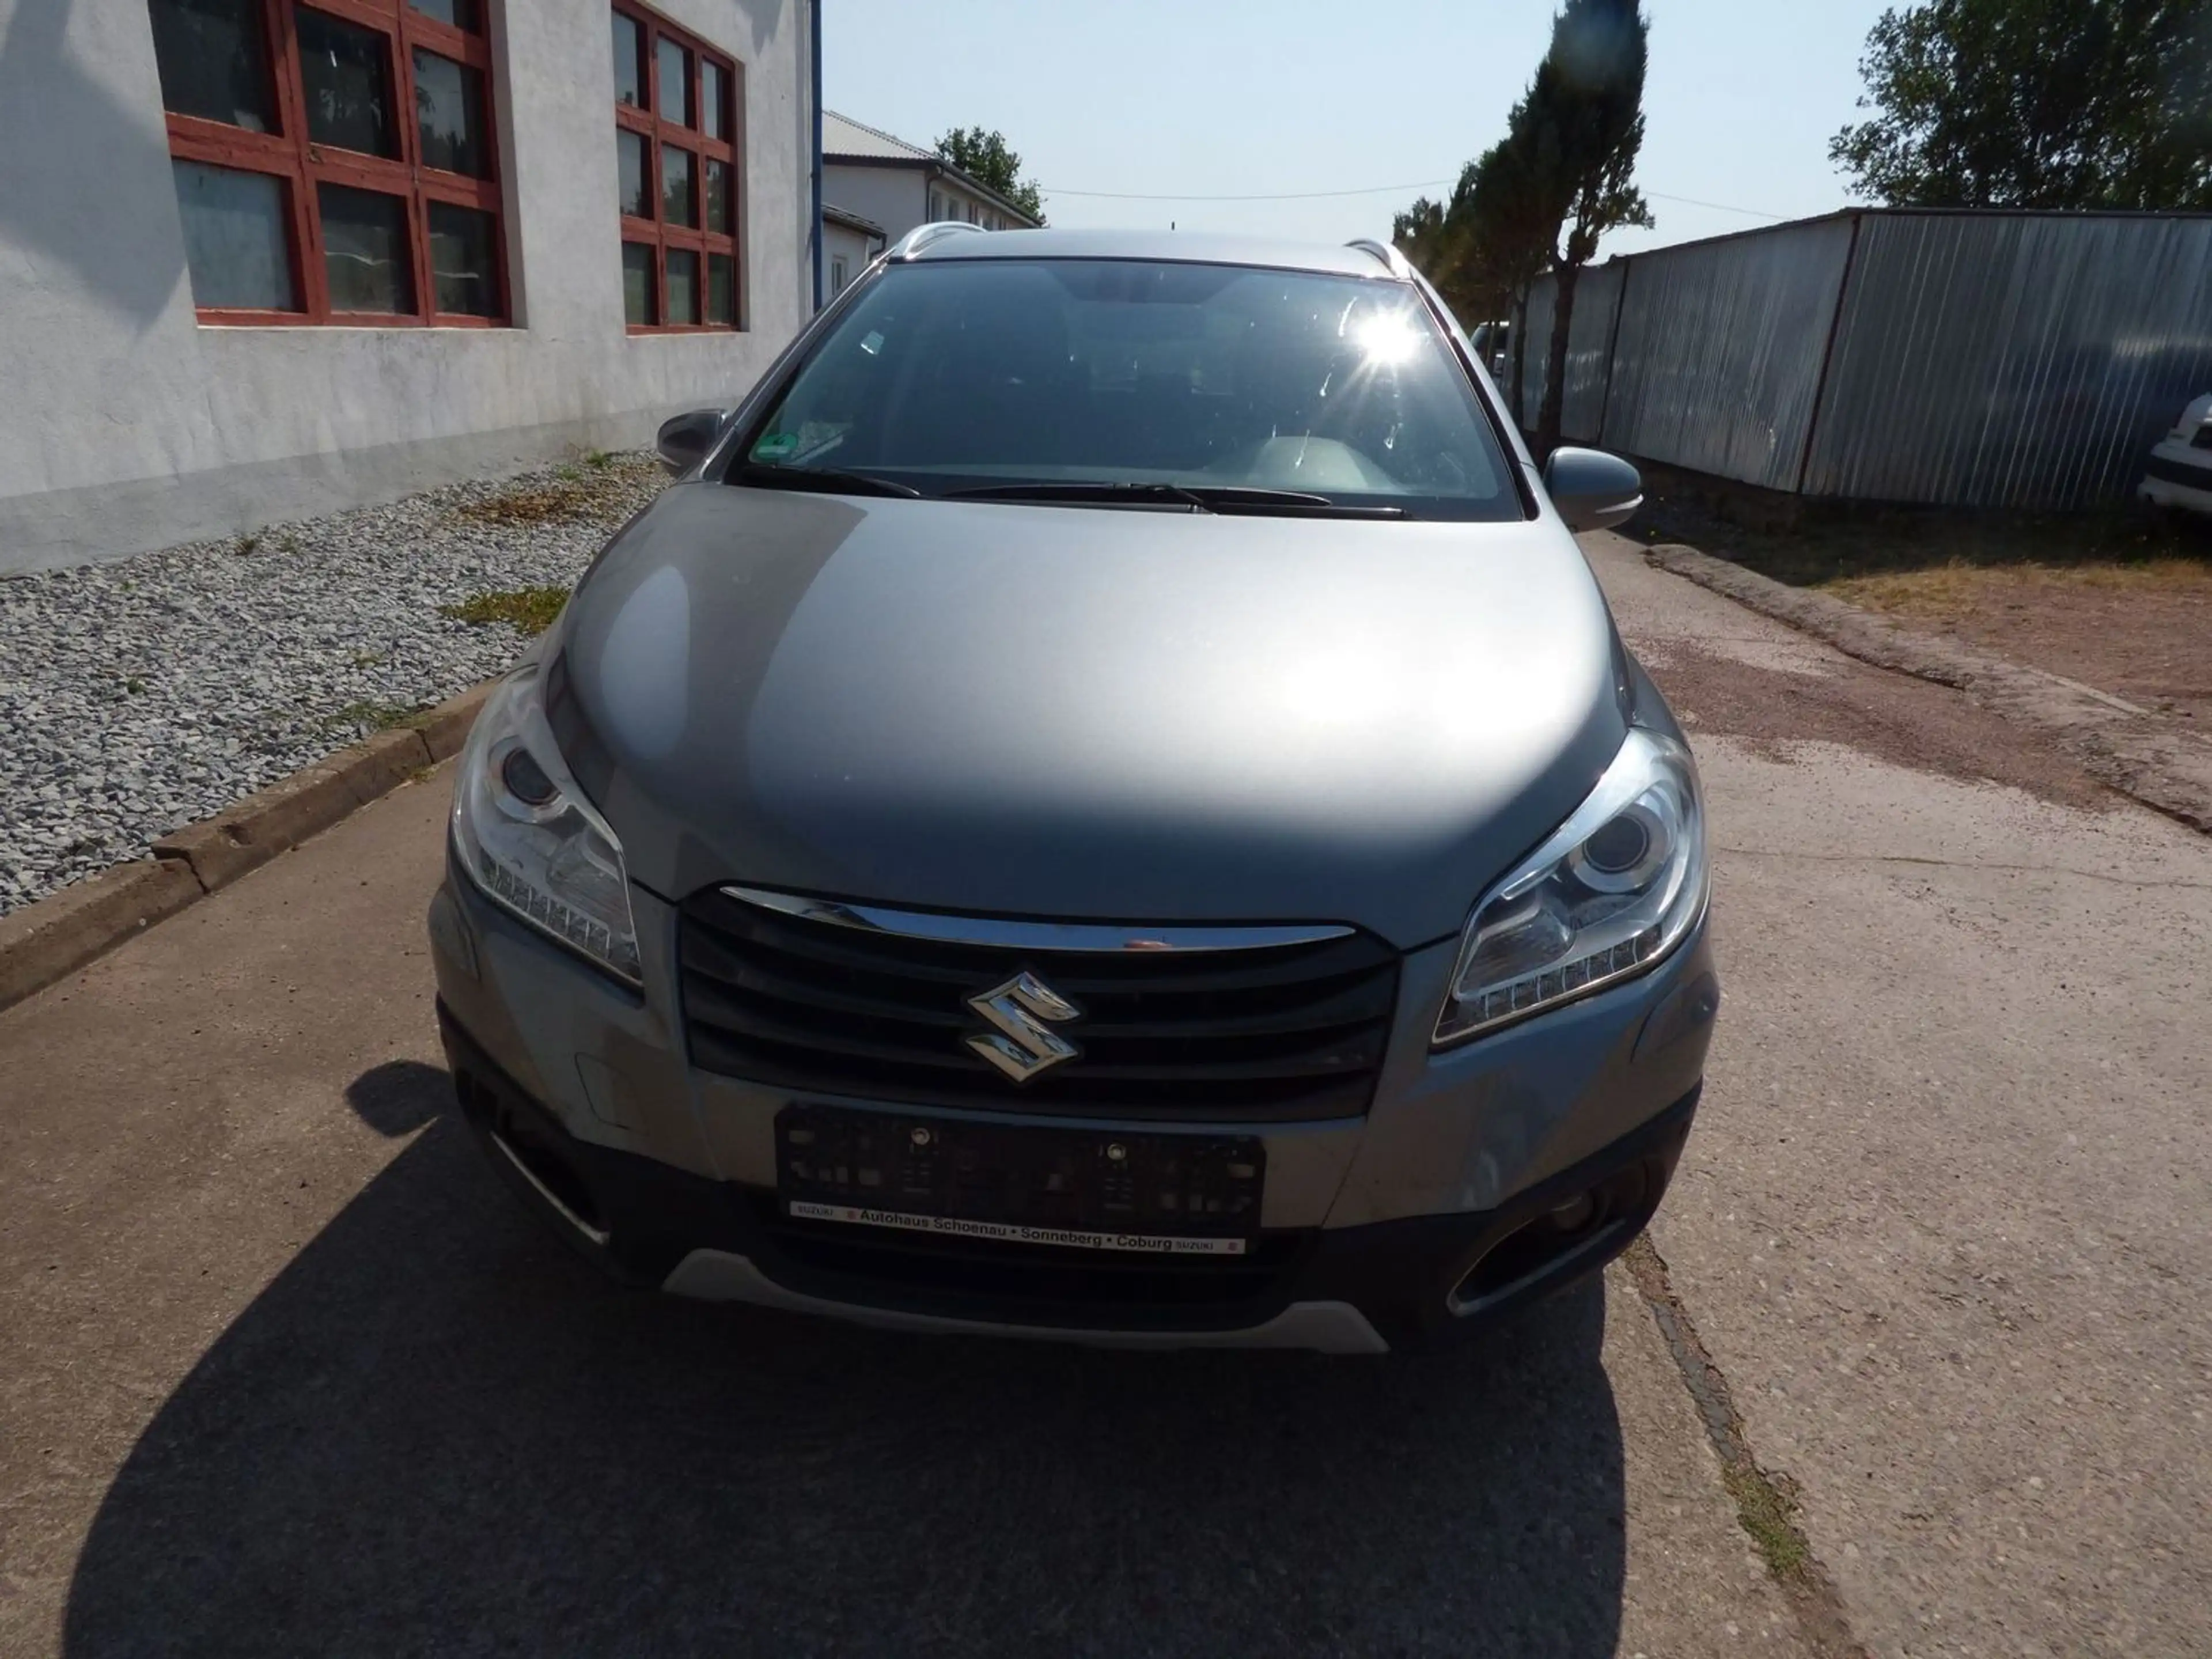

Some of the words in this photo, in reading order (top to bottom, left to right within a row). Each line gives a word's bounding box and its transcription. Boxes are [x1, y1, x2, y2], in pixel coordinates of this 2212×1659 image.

[798, 1205, 834, 1216] SUZUKI
[861, 1209, 929, 1228] Autohaus
[934, 1218, 1006, 1236] Schoenau
[1021, 1228, 1103, 1247] Sonneberg
[1117, 1234, 1172, 1250] Coburg
[1176, 1240, 1214, 1251] SUZUKI
